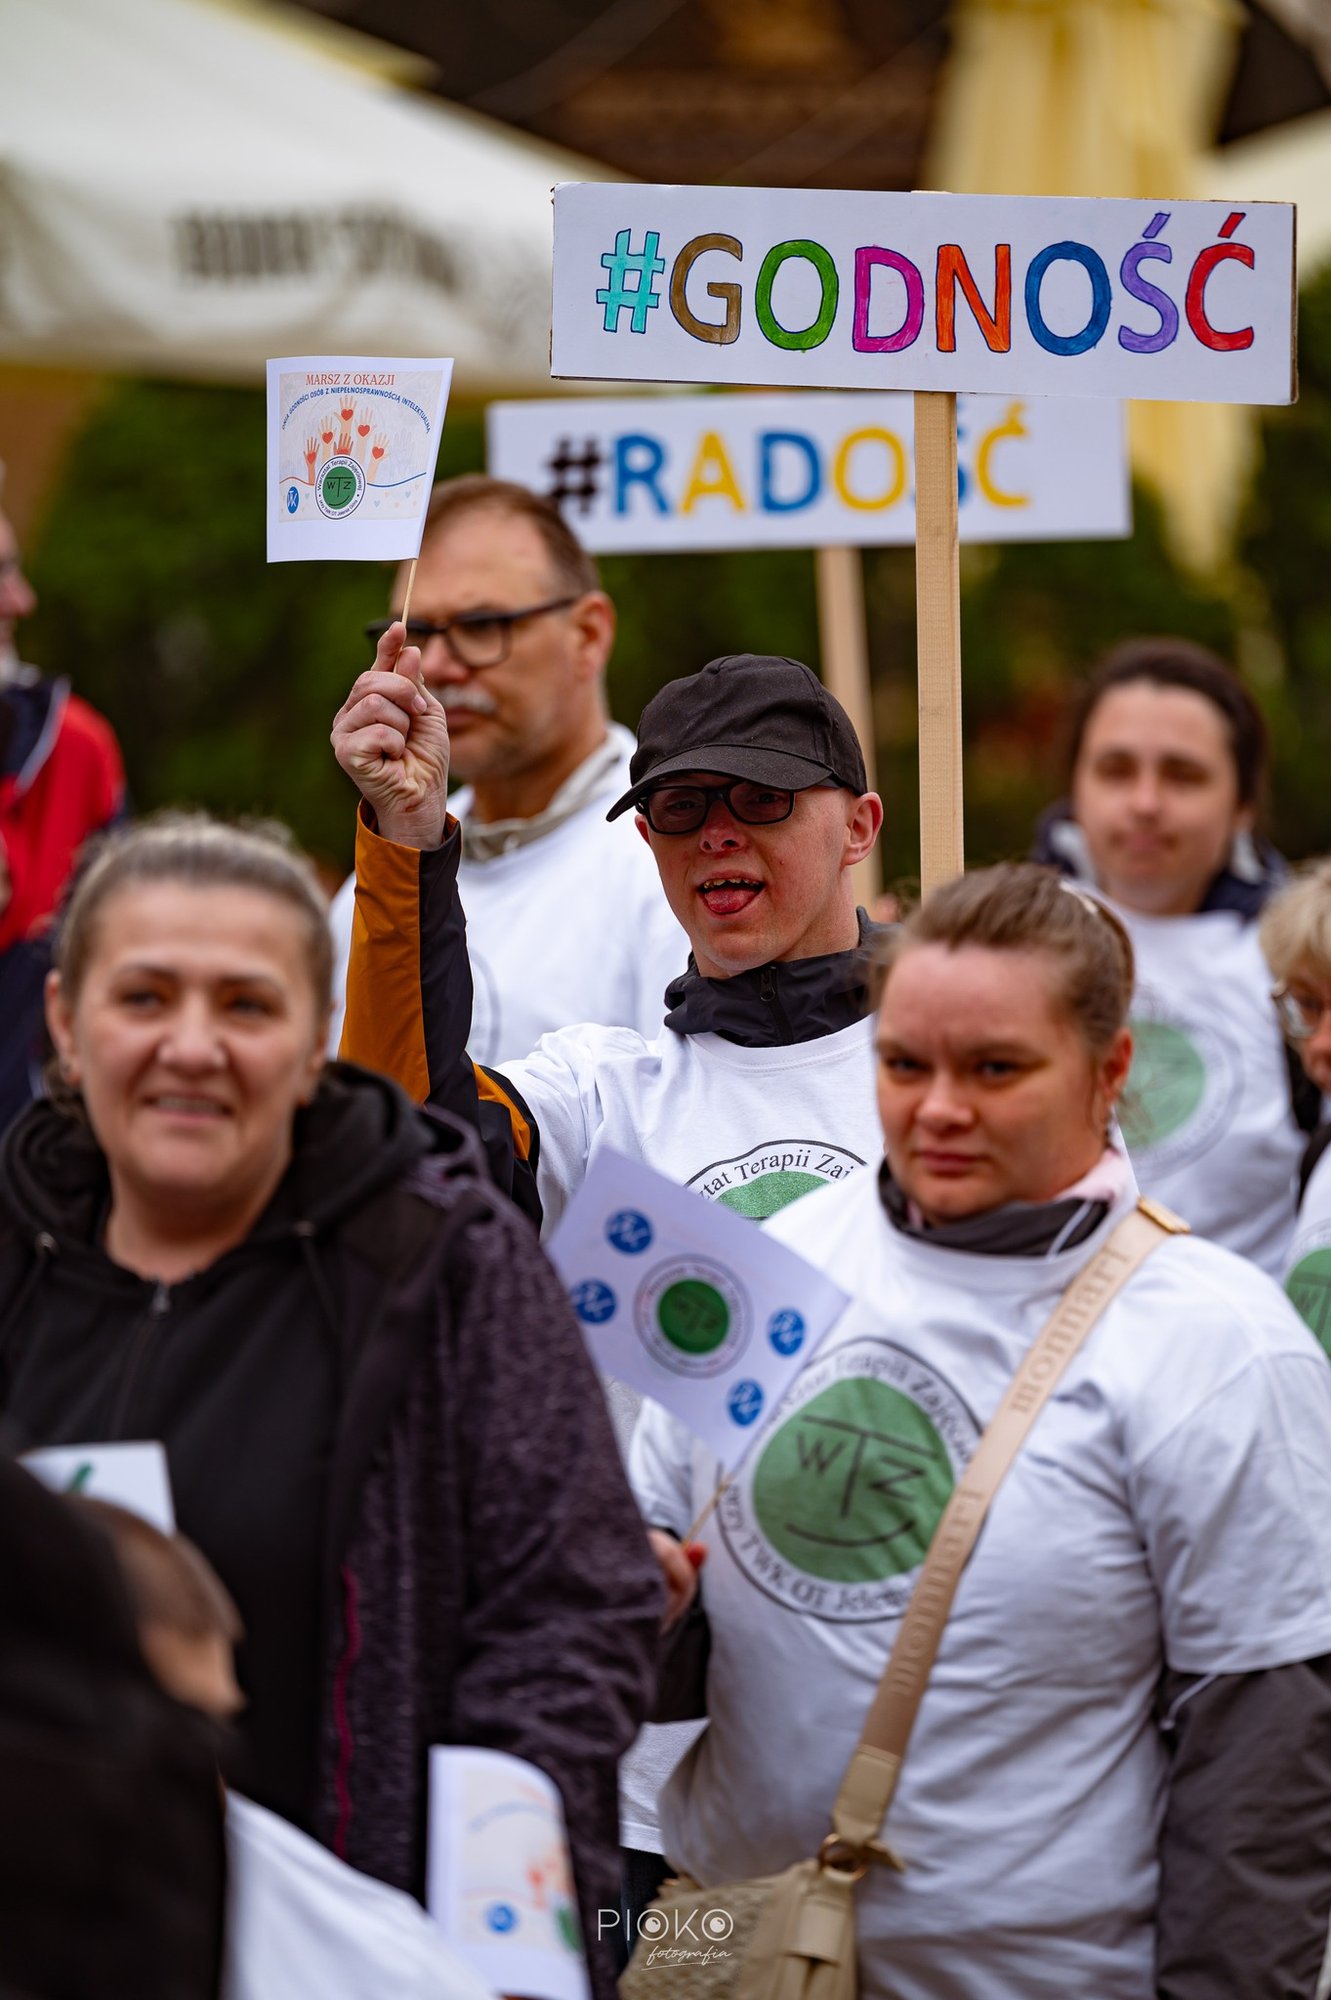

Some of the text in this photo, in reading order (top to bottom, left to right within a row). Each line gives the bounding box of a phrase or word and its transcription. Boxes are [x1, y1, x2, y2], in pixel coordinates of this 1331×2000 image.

[596, 211, 1256, 356] #GODNOŚĆ
[305, 373, 395, 386] MARSZ Z OKAZJI
[309, 388, 324, 399] OSÓB
[325, 387, 330, 395] Z
[546, 403, 1032, 520] #RADOĆ
[733, 1149, 812, 1181] Terapii
